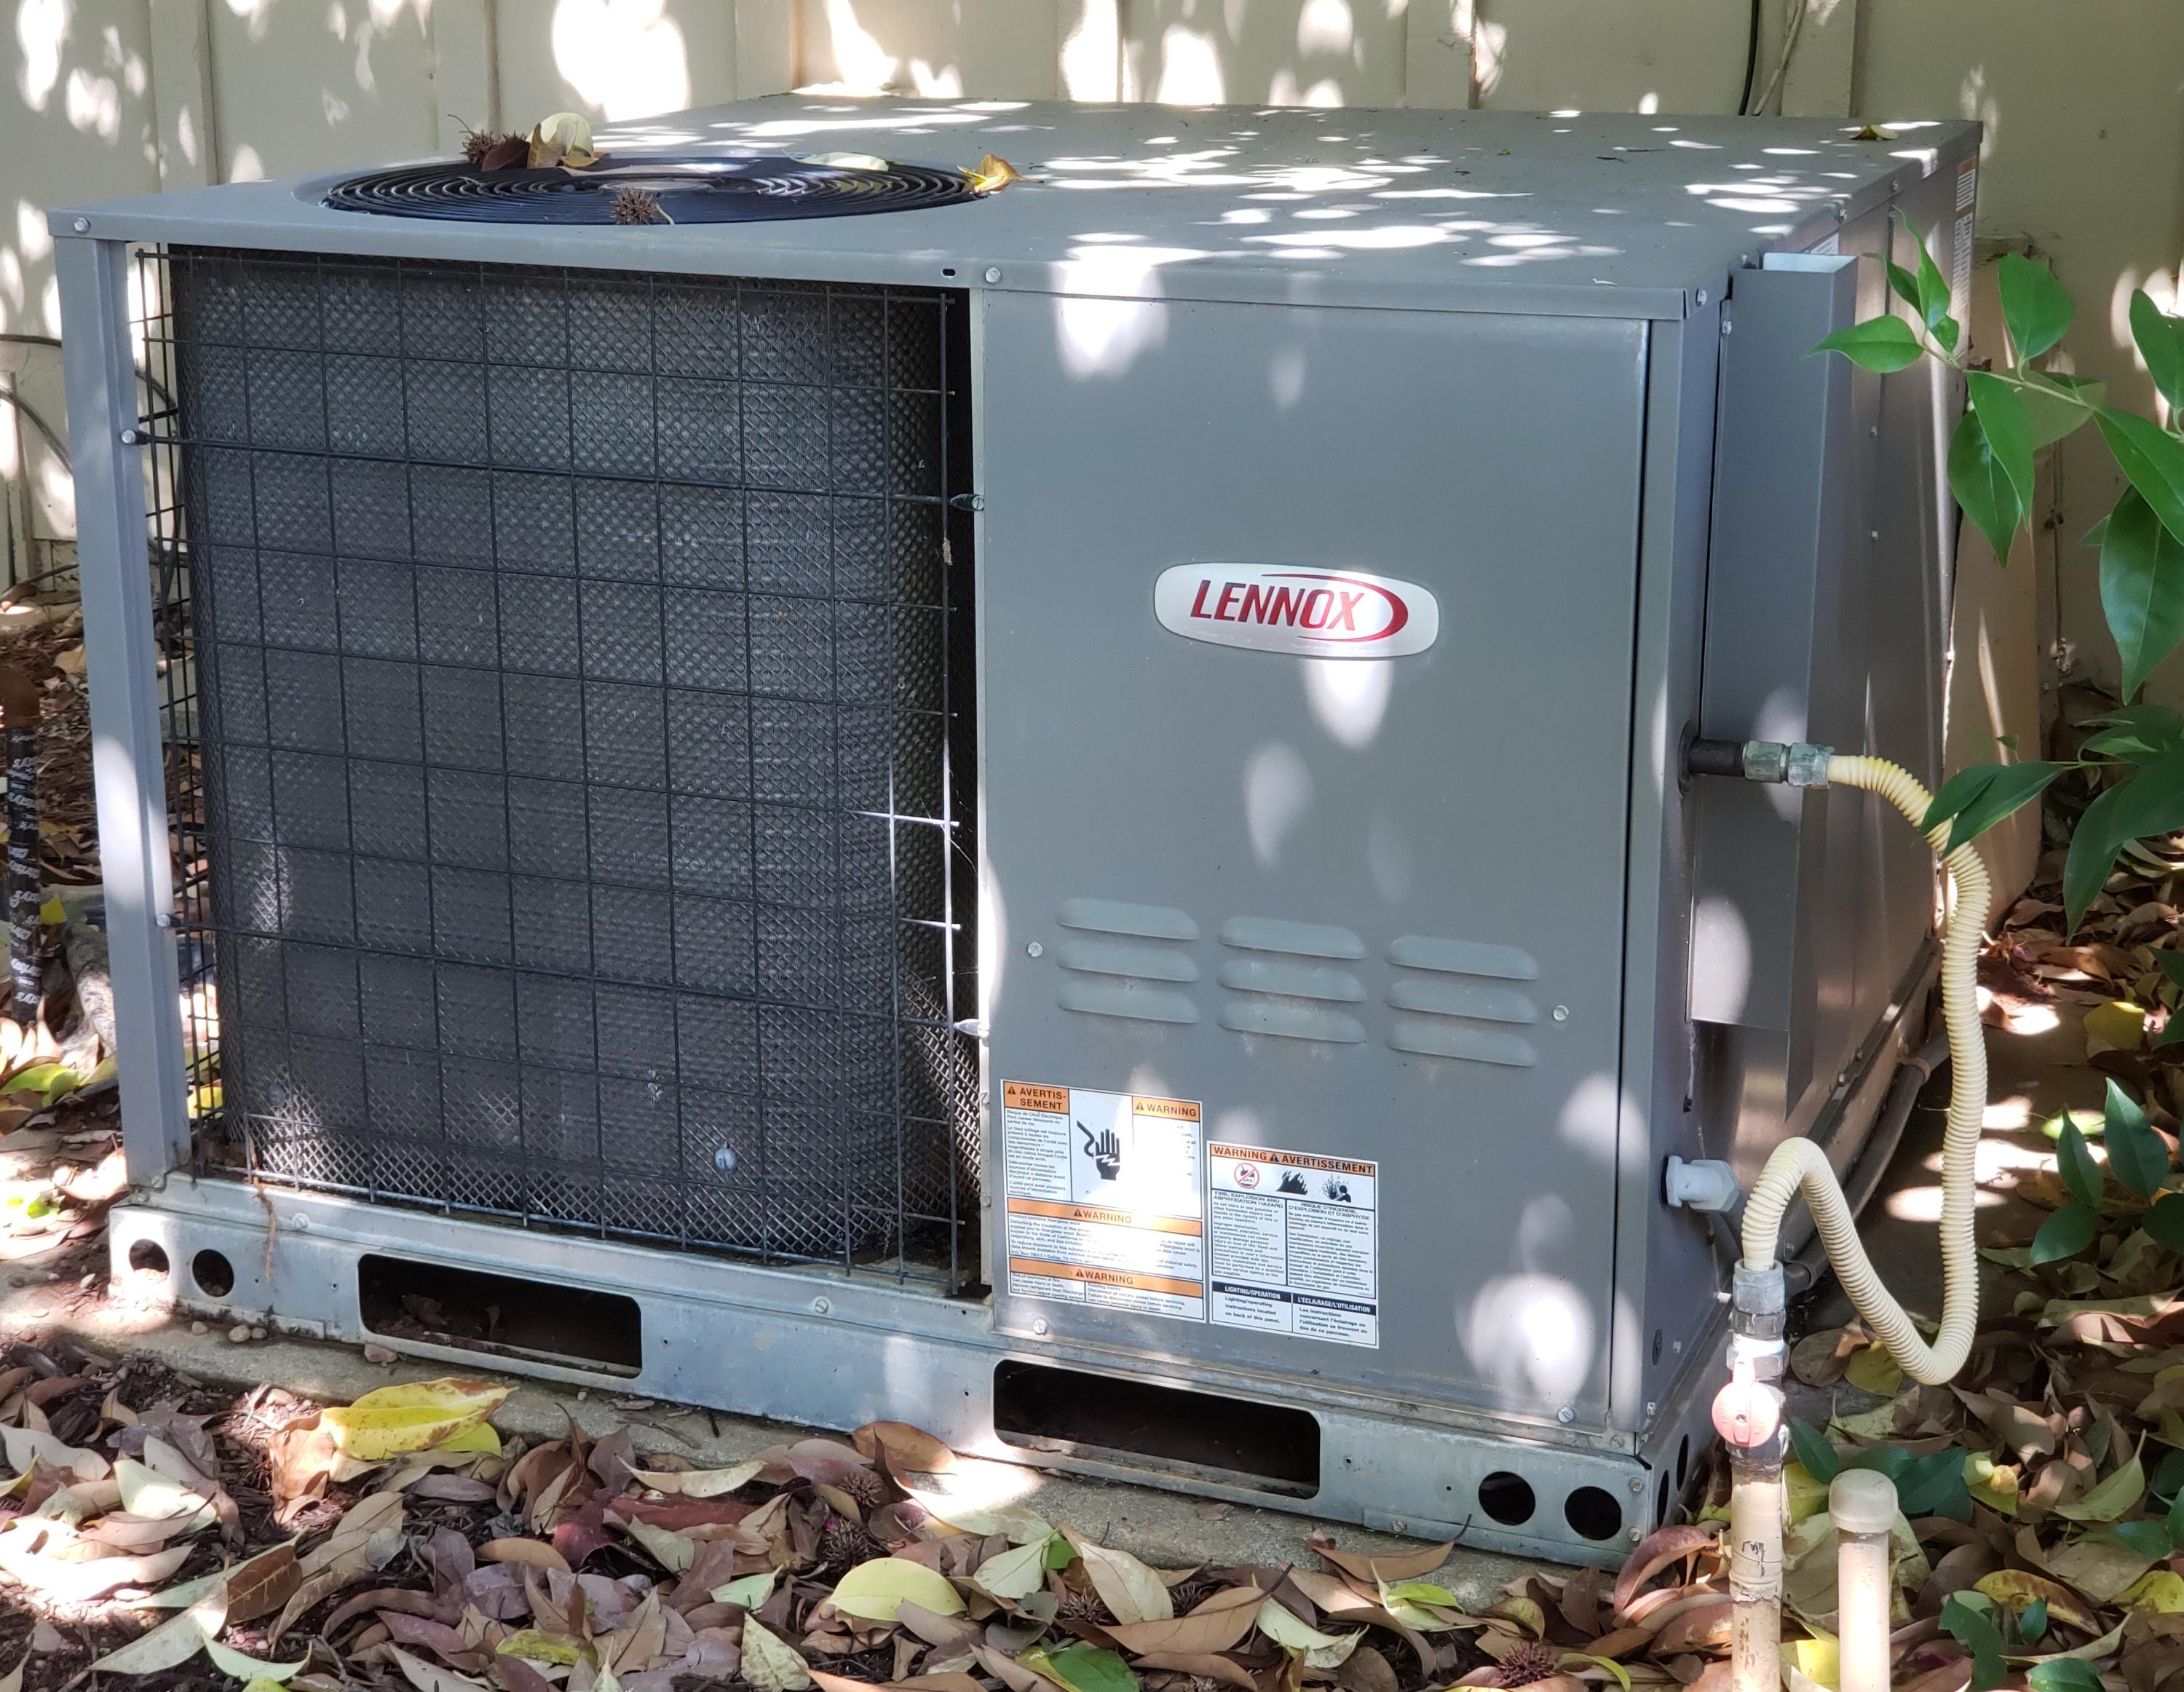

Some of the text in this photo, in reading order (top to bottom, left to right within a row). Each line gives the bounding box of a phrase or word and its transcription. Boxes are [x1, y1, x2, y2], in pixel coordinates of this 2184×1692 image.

[1190, 580, 1364, 631] LENNOX
[1020, 1087, 1067, 1100] AVERTIS-
[1020, 1098, 1063, 1110] SEMENT
[1147, 1103, 1197, 1117] WARNING
[1214, 1145, 1374, 1174] WARNING AVERTISSEMENT
[1214, 1195, 1257, 1204] ASPHYXIATION
[1230, 1193, 1265, 1201] EXPLOSION
[1083, 1209, 1131, 1224] WARNING
[1289, 1205, 1326, 1214] D'EXPLOSION
[1085, 1269, 1133, 1285] WARNING
[1224, 1285, 1280, 1299] LIGHTING/OPERATION
